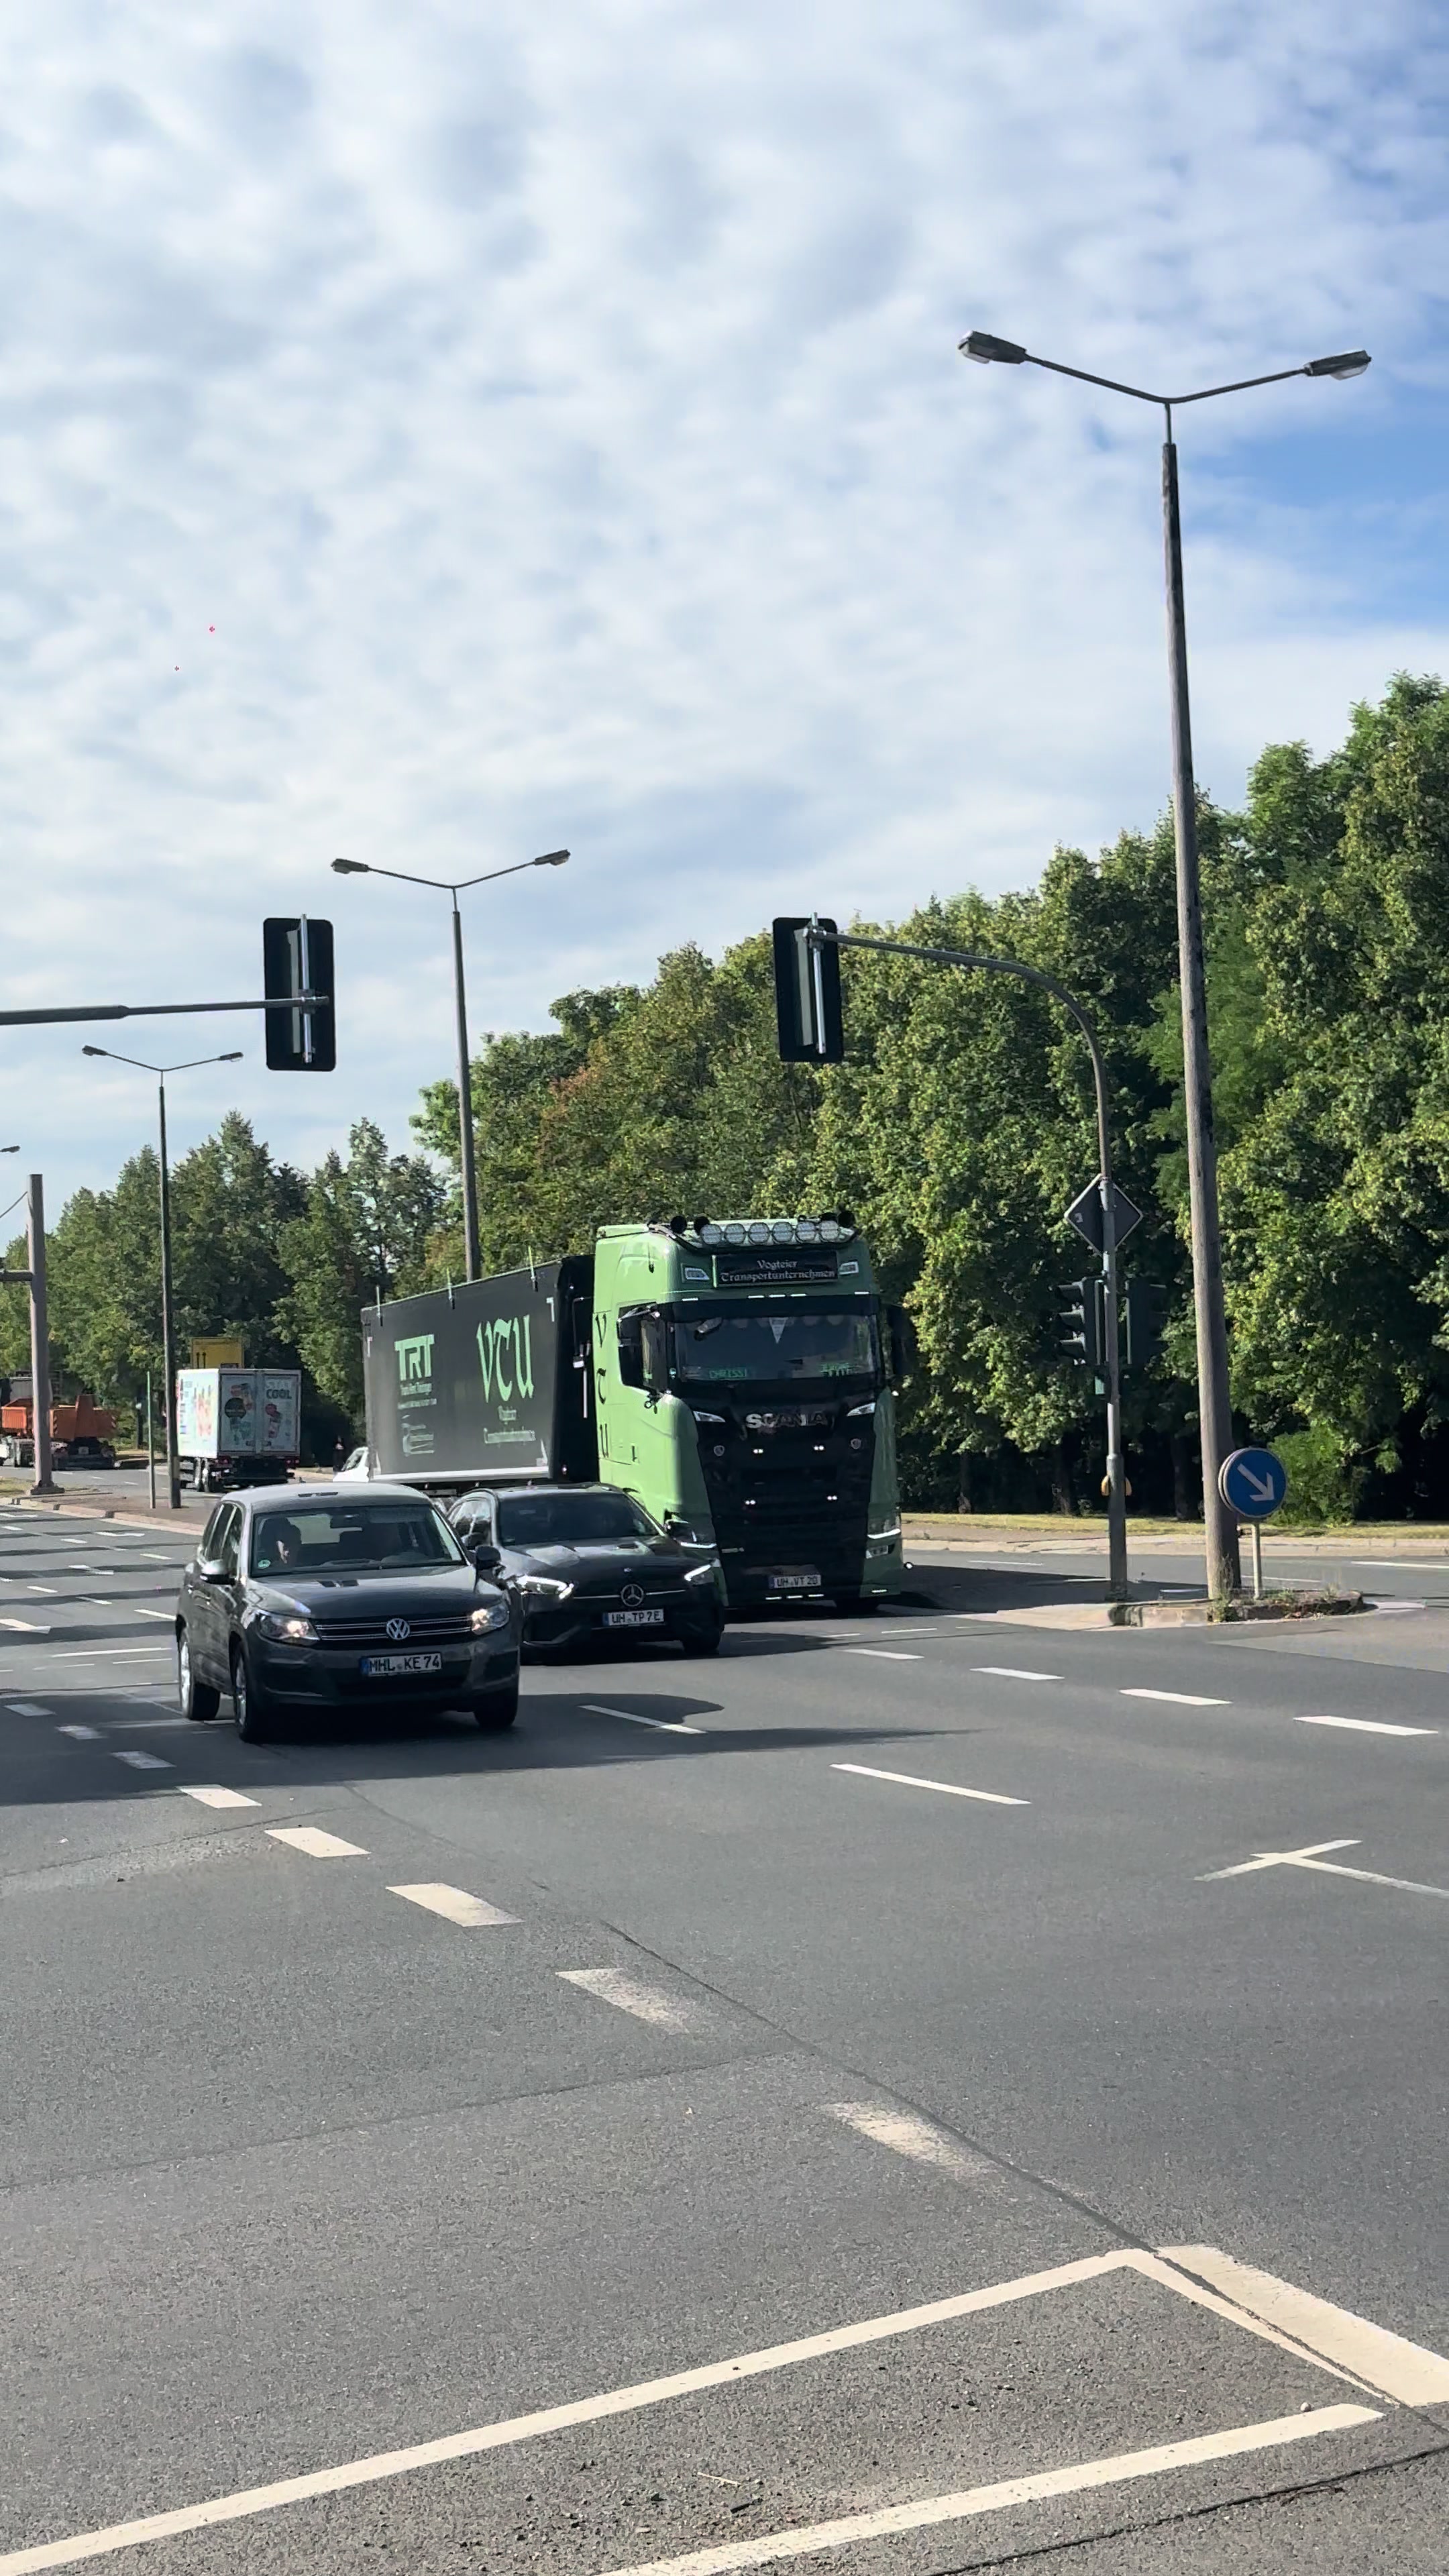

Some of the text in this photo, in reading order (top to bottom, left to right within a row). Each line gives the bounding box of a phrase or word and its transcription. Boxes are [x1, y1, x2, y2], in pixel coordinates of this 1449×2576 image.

[266, 1389, 292, 1399] COOL
[745, 1412, 828, 1429] SCANIA
[611, 1613, 626, 1623] UH
[369, 1658, 396, 1672] MHL
